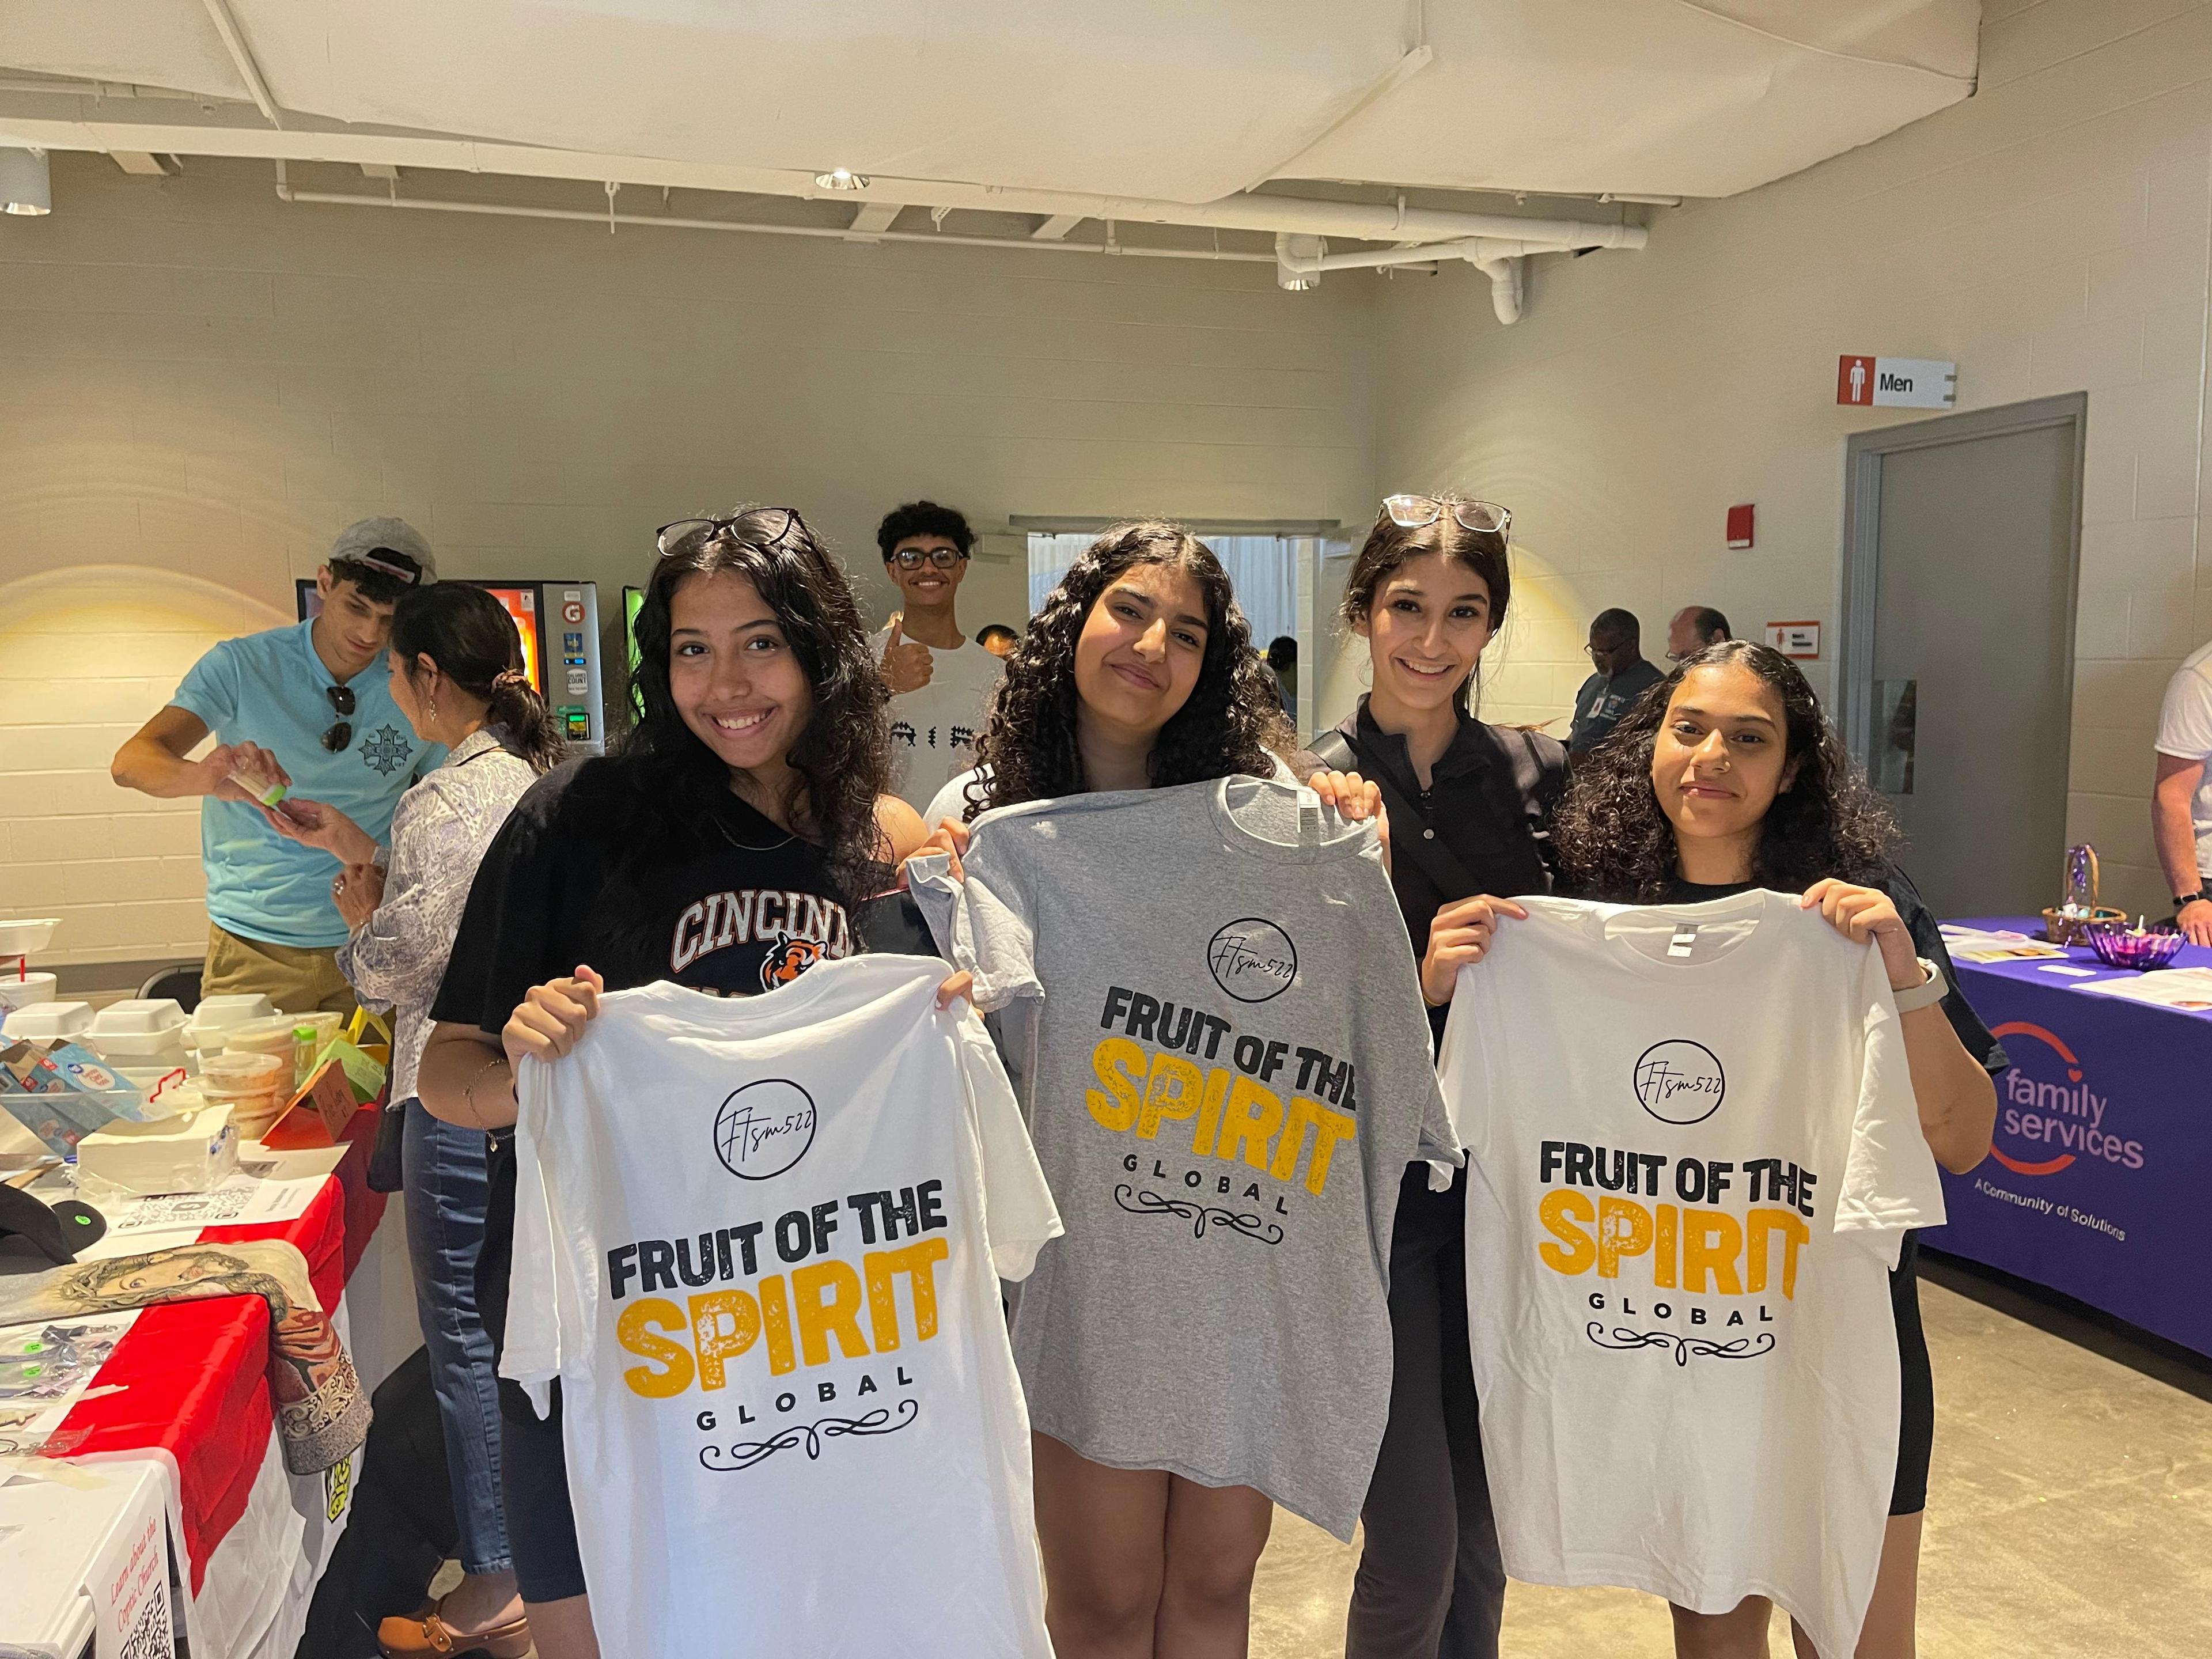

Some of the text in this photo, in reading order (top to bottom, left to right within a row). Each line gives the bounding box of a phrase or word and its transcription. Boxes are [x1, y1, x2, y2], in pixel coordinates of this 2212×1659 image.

[1880, 373, 1913, 392] Men
[565, 604, 580, 622] G
[1100, 986, 1231, 1059] FRUIT
[1233, 1035, 1289, 1083] OF
[1085, 1037, 1356, 1196] SPIRIT
[2006, 1068, 2107, 1129] family
[2004, 1108, 2144, 1169] services
[1123, 1154, 1289, 1215] GLOBAL
[1540, 1141, 1817, 1218] FRUIT OF THE
[1974, 1179, 2126, 1241] A Community of Solutions
[607, 1179, 948, 1300] FRUIT OF THE
[1539, 1188, 1810, 1301] SPIRIT
[616, 1237, 949, 1399] SPIRIT
[1589, 1293, 1773, 1327] GLOBAL
[696, 1366, 913, 1431] GLOBAL
[111, 1516, 156, 1607] Learn about the
[118, 1544, 158, 1633] Coptic Church
